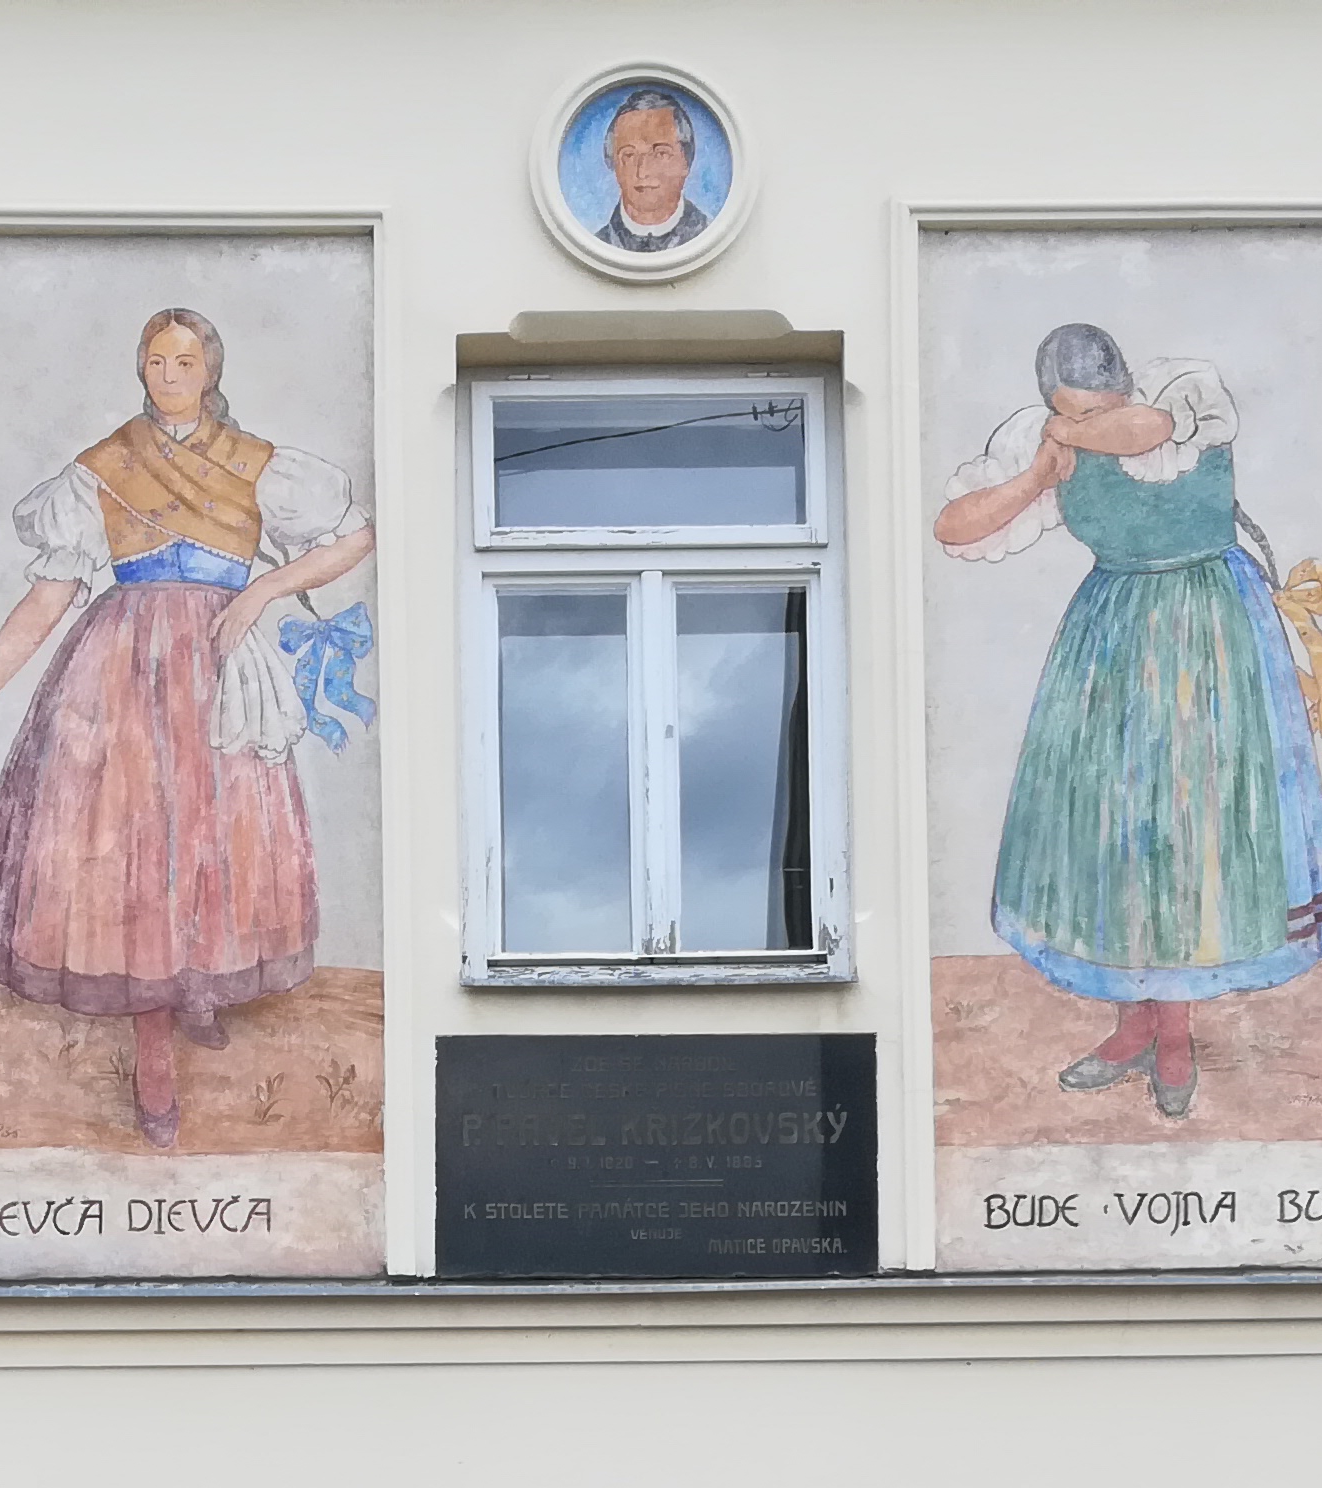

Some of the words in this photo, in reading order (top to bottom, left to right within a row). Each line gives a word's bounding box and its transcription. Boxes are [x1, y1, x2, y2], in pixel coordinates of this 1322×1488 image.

[127, 1195, 272, 1235] DIEVČA
[463, 1202, 477, 1220] K
[678, 1200, 729, 1218] JEHO
[737, 1199, 848, 1218] NAROZENIN
[983, 1193, 1080, 1230] BUDE
[707, 1237, 767, 1255] MATICE
